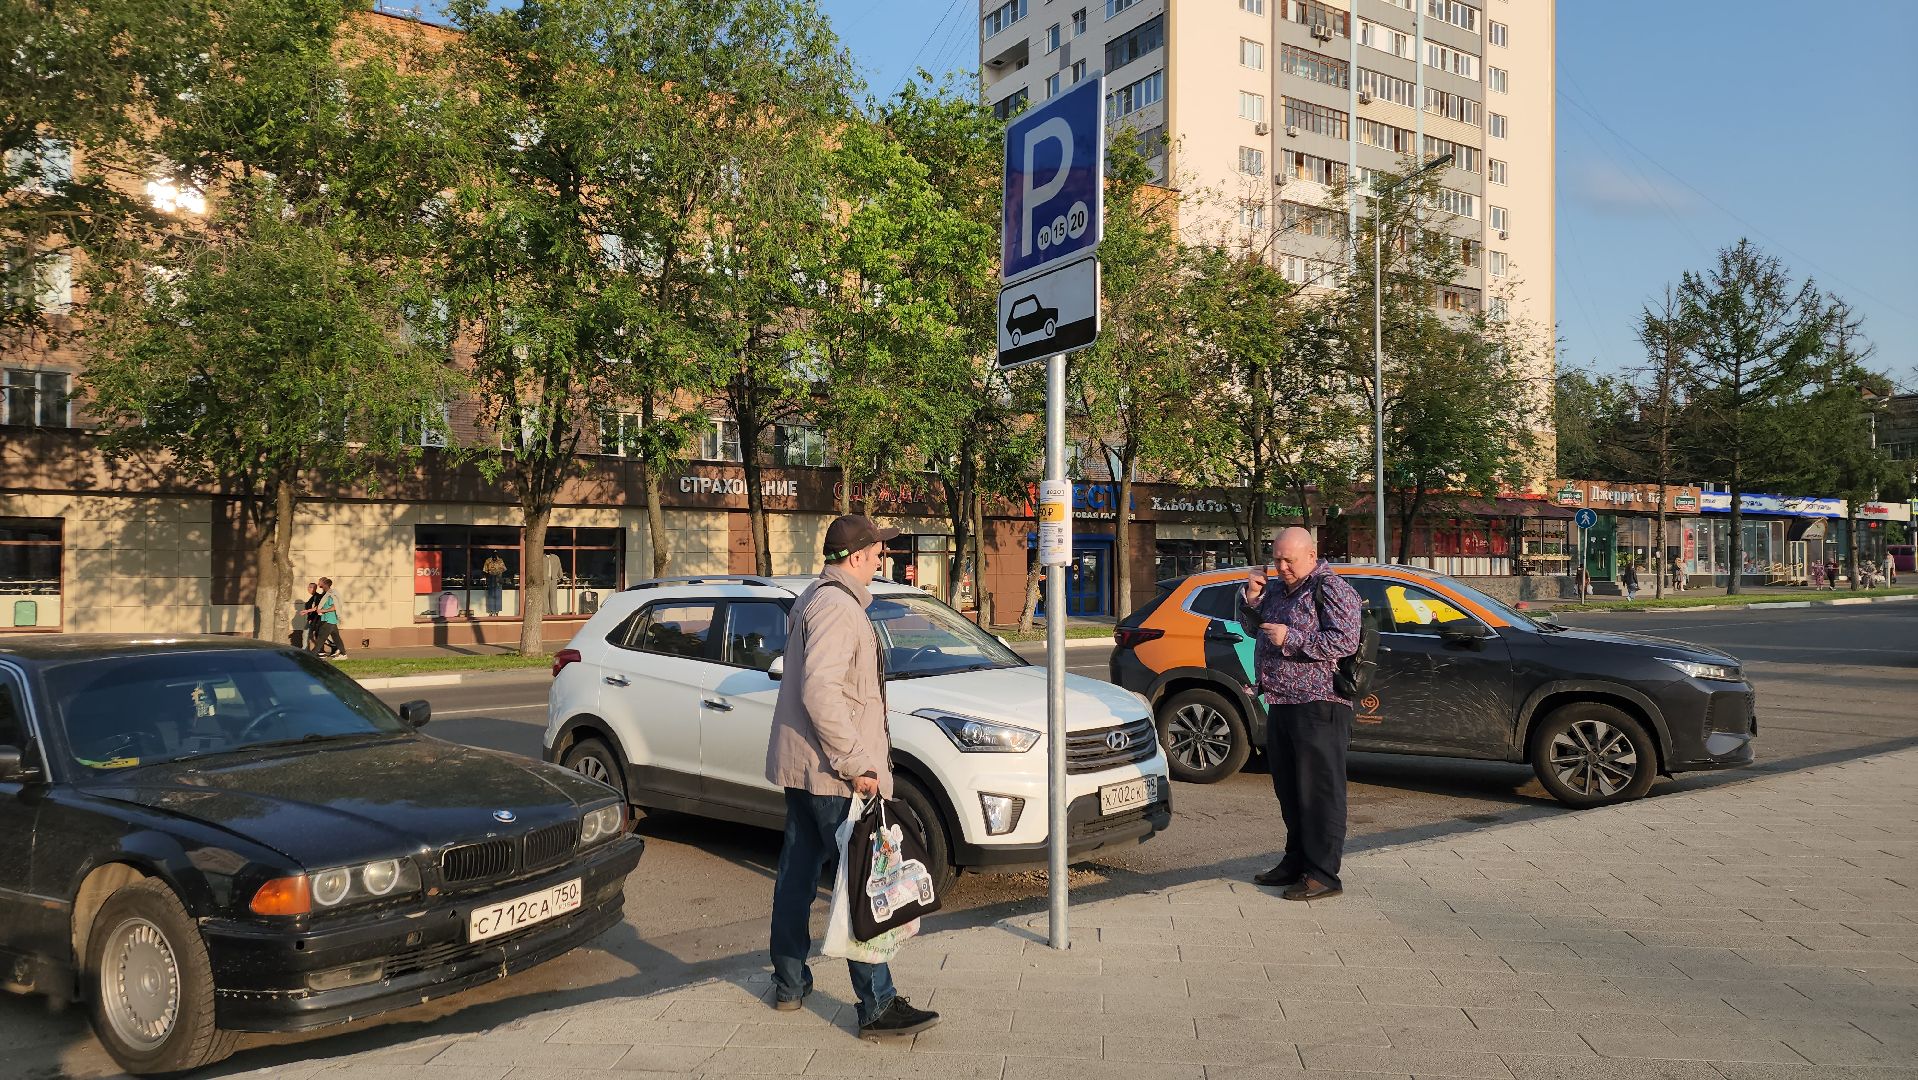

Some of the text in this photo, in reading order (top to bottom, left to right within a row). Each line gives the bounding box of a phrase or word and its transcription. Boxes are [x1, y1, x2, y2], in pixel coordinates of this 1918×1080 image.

[1021, 117, 1074, 258] P
[1040, 210, 1085, 246] 10 15 20
[680, 476, 798, 497] СТРАХОНИЕ
[1648, 492, 1667, 503] па
[416, 567, 440, 577] 50%
[478, 883, 577, 935] С712СА 750
